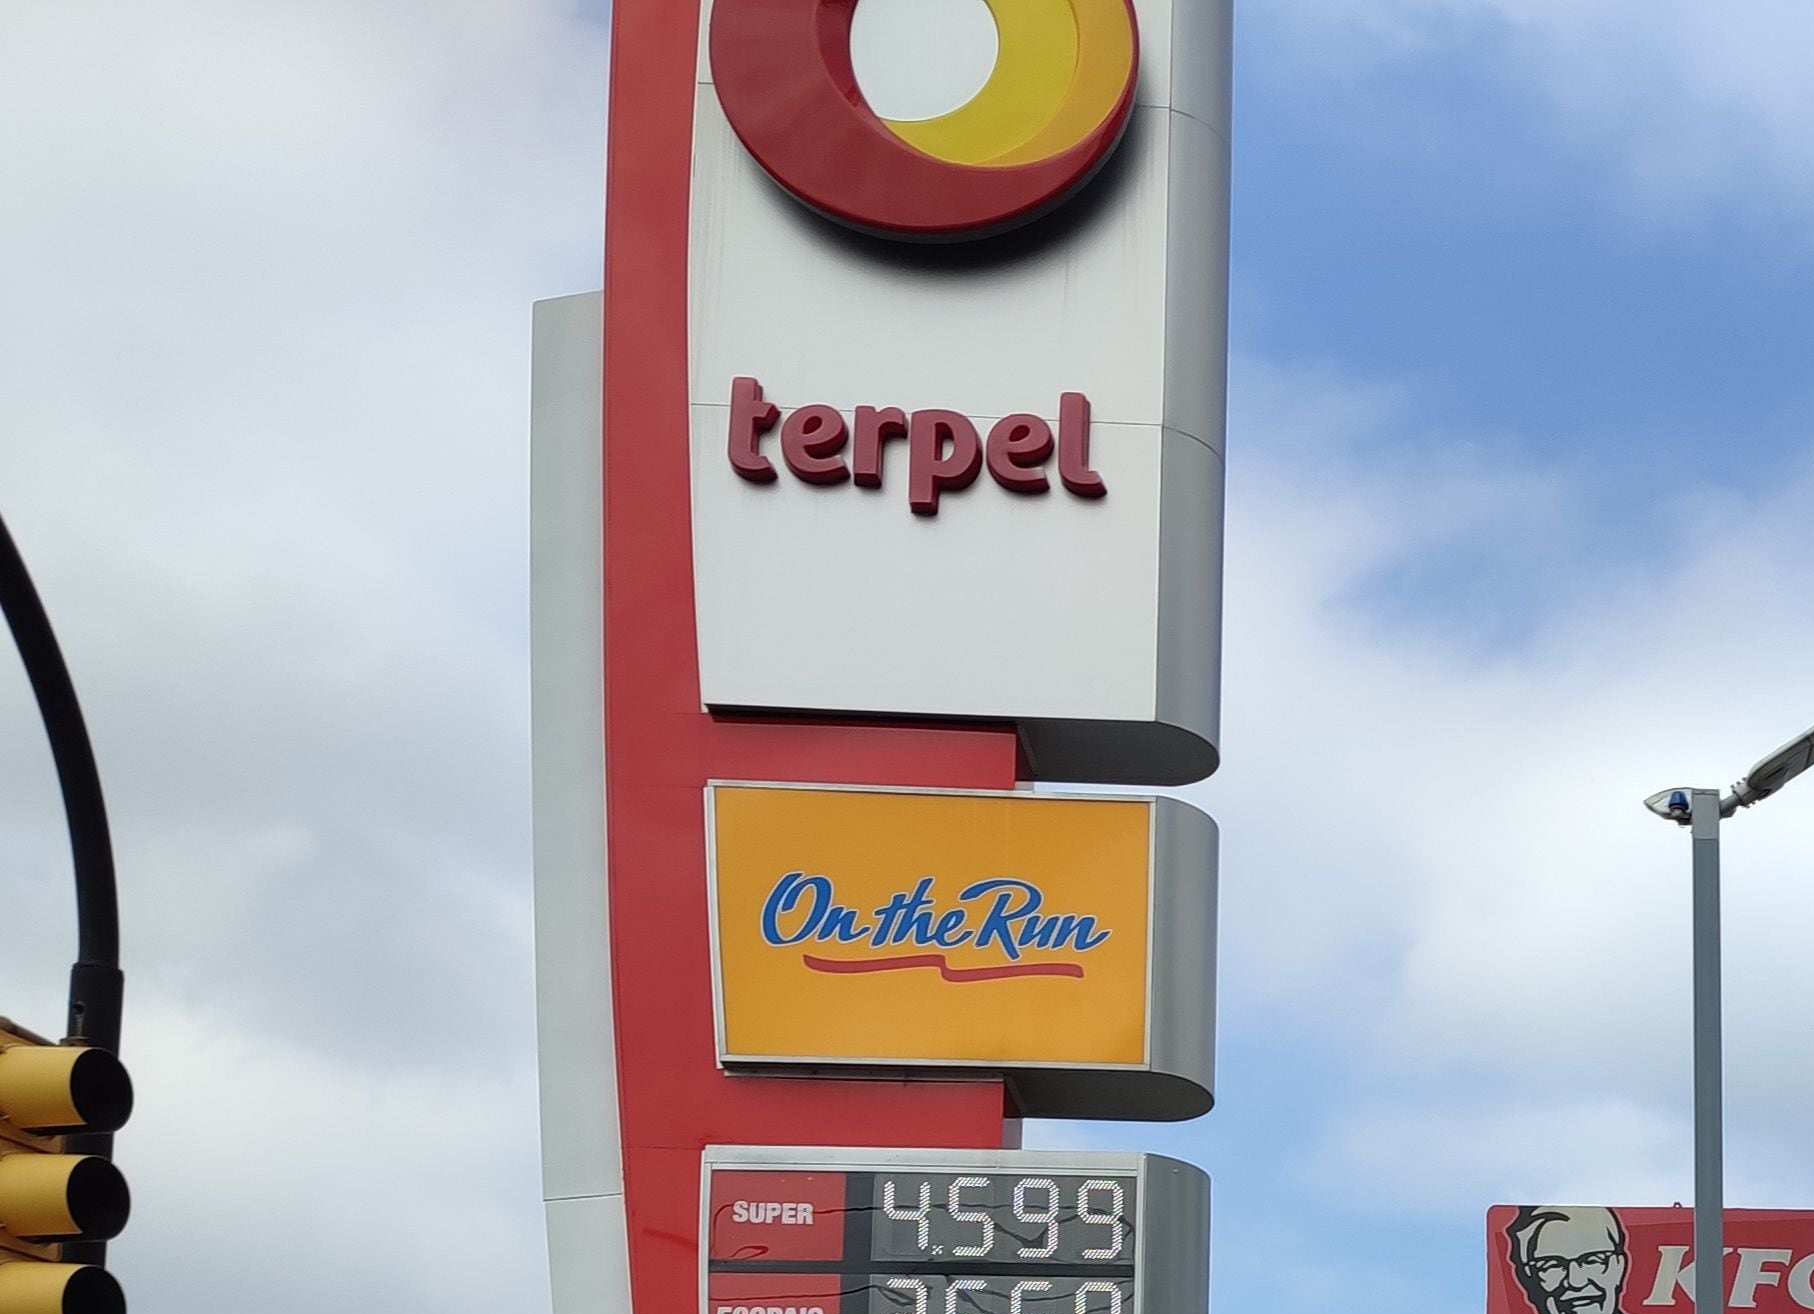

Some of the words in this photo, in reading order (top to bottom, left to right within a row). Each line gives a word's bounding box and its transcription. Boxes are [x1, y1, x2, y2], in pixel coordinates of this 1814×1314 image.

[727, 376, 1107, 516] terpel
[761, 871, 871, 947] On
[869, 877, 975, 948] the
[958, 878, 1112, 961] Run
[732, 1200, 815, 1225] SUPER
[884, 1177, 1124, 1260] 4.599
